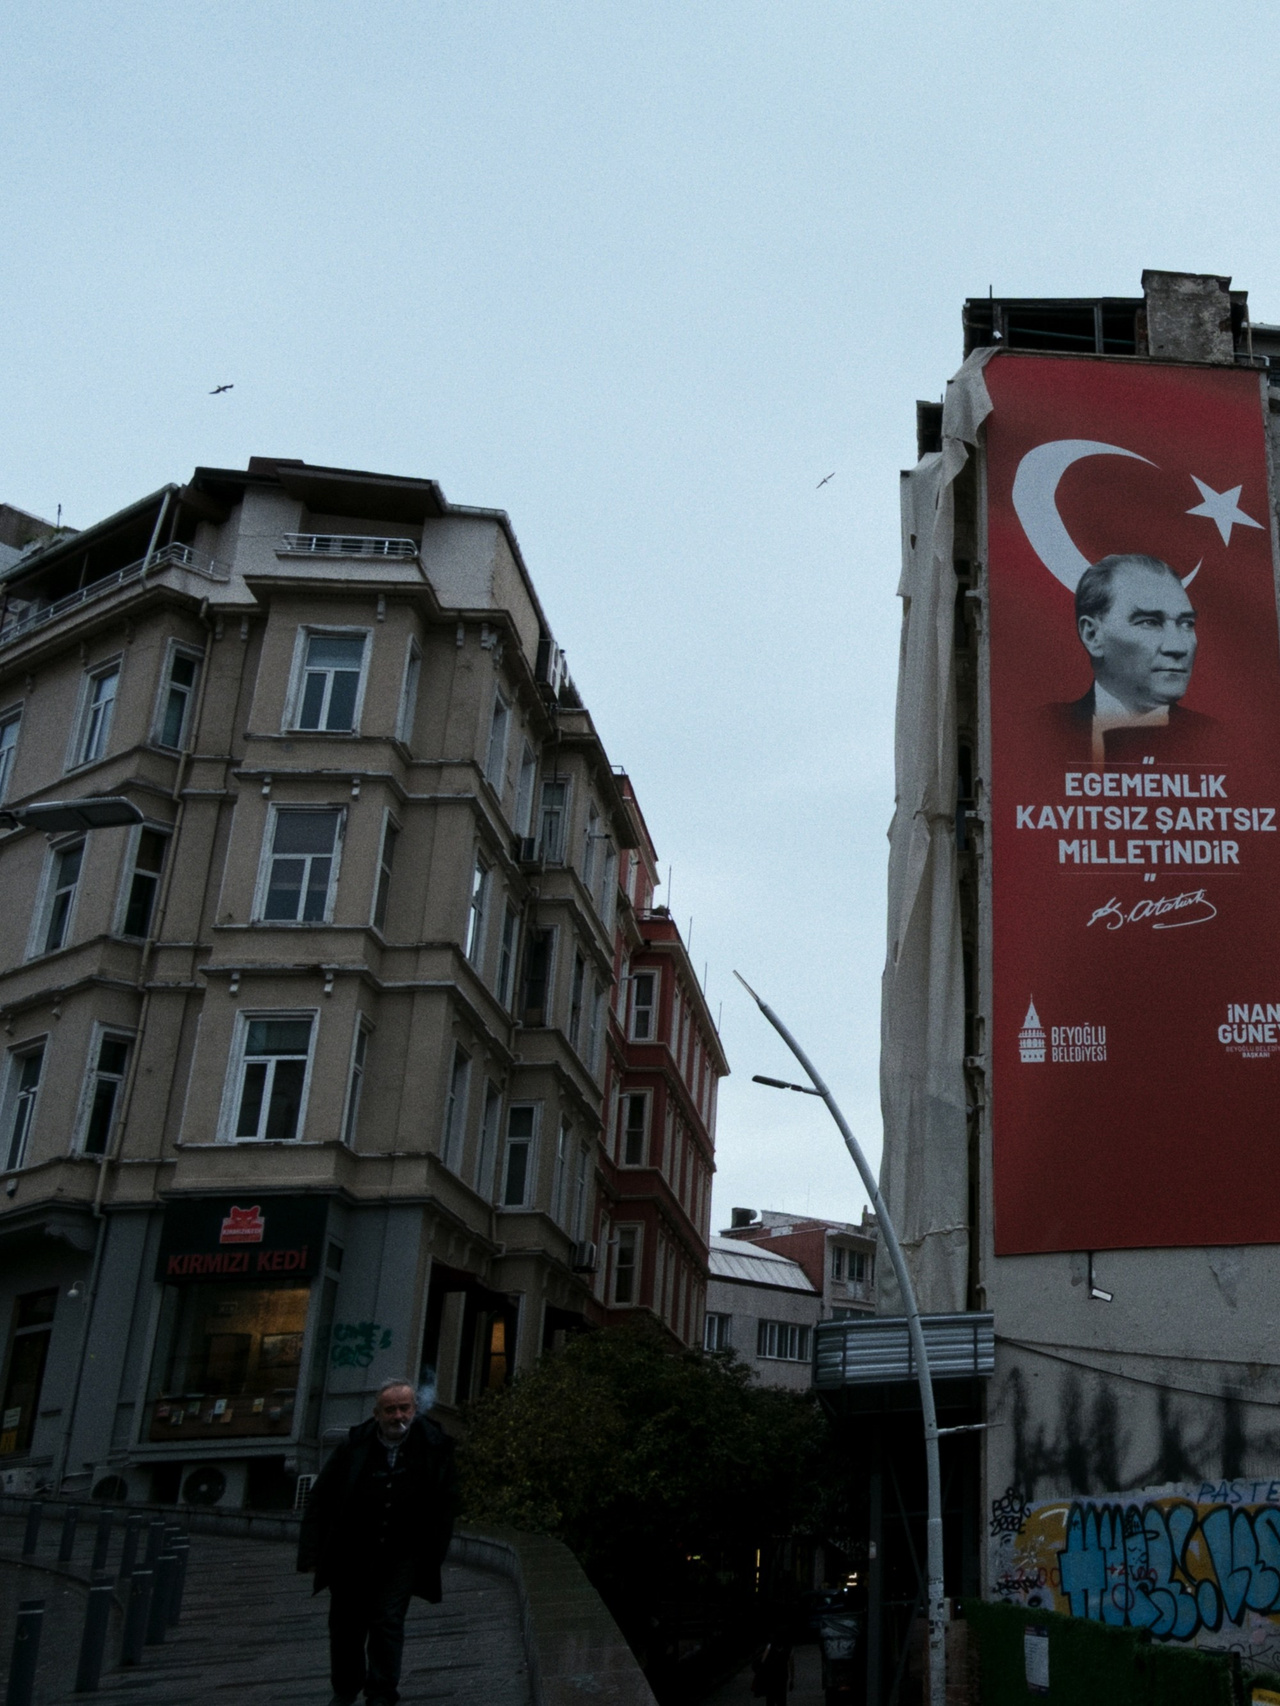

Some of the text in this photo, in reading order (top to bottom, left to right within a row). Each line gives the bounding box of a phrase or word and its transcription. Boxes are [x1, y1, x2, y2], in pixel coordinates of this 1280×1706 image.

[1065, 773, 1228, 798] EGEMENLİK
[1015, 805, 1277, 834] KAYITSIZ ŞARTSIZ
[1058, 839, 1240, 864] MİLLETİNDİR
[1051, 1022, 1106, 1045] BEYOĞLU
[1052, 1045, 1107, 1063] BELEDİYESİ
[166, 1245, 309, 1275] KIRMIZI KEDİ
